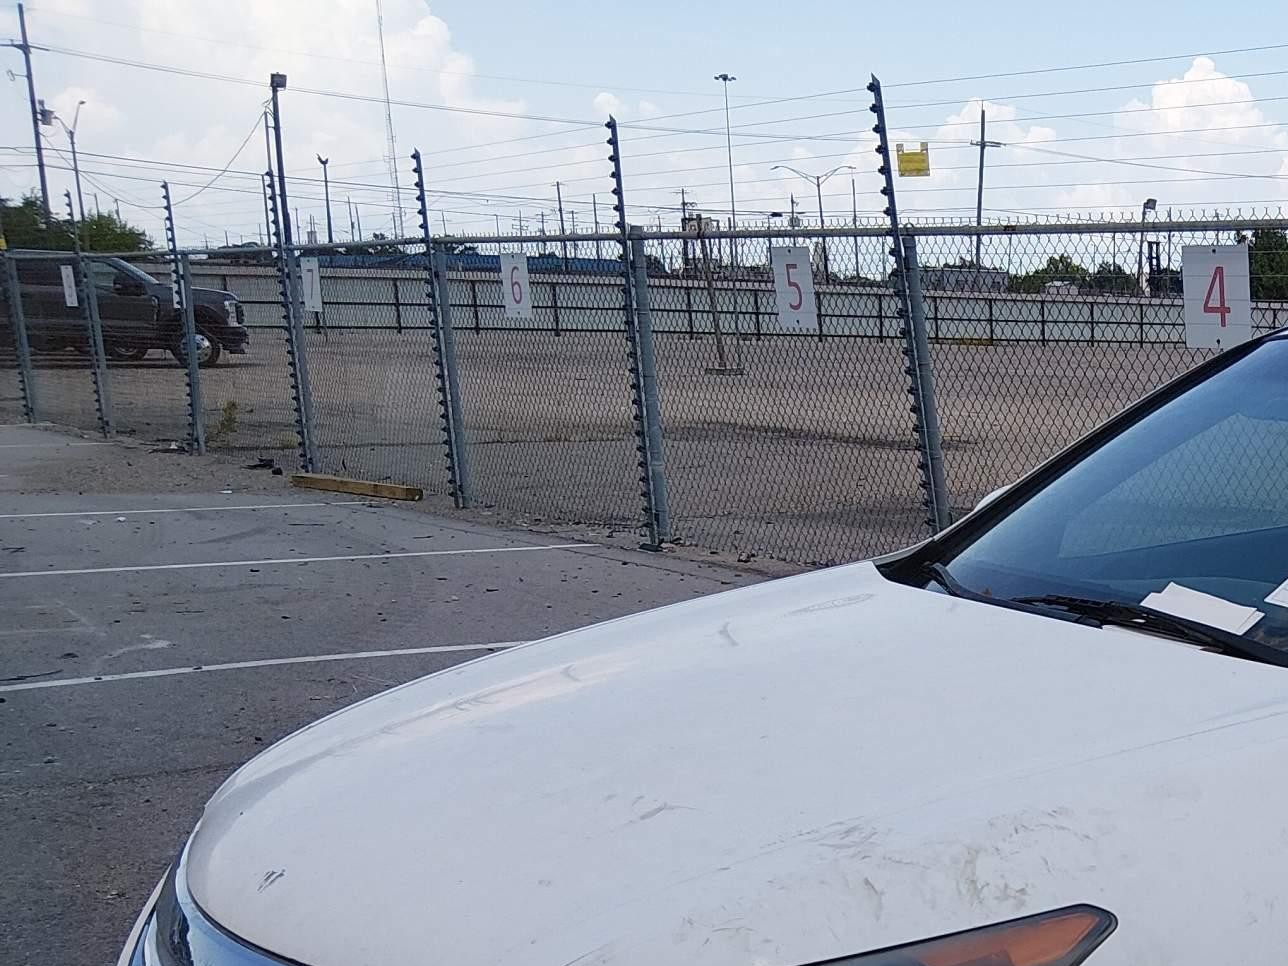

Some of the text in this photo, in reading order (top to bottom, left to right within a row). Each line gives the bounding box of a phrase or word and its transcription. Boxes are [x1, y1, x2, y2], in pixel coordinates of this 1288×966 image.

[304, 267, 314, 301] 7
[510, 265, 522, 304] 6
[785, 263, 803, 310] 5
[1203, 266, 1231, 328] 4
